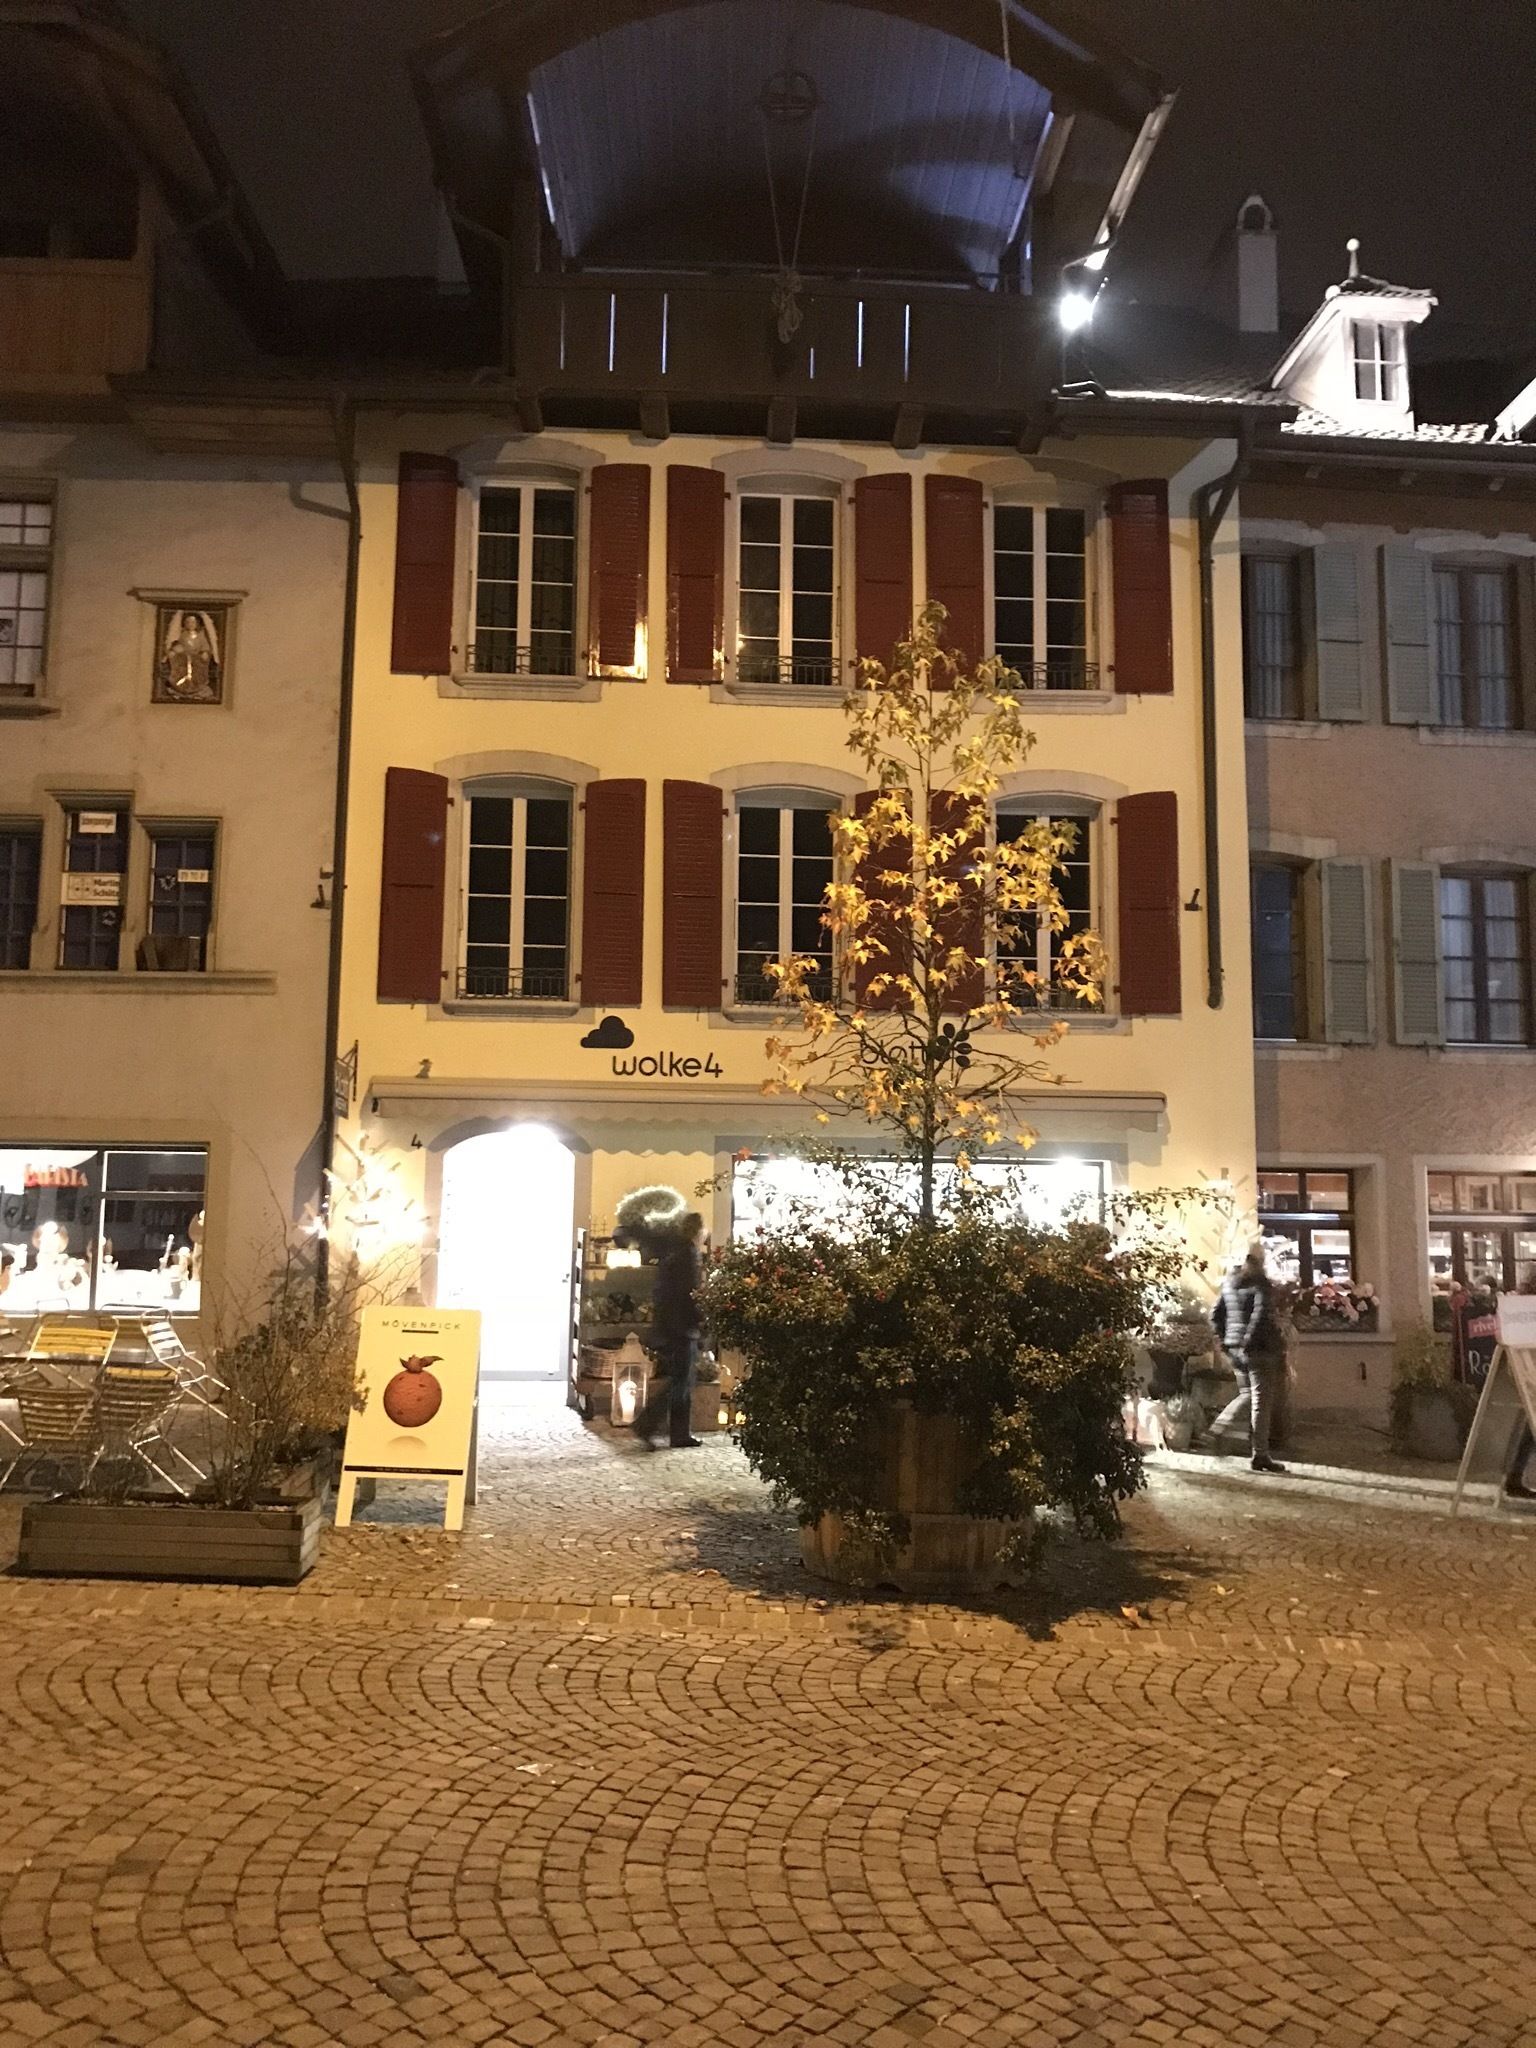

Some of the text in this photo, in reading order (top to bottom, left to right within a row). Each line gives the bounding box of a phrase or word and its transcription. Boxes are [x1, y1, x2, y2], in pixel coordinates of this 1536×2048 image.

[612, 1050, 724, 1078] wolke4
[410, 1133, 423, 1149] 4
[382, 1320, 462, 1330] MÖVENPICK
